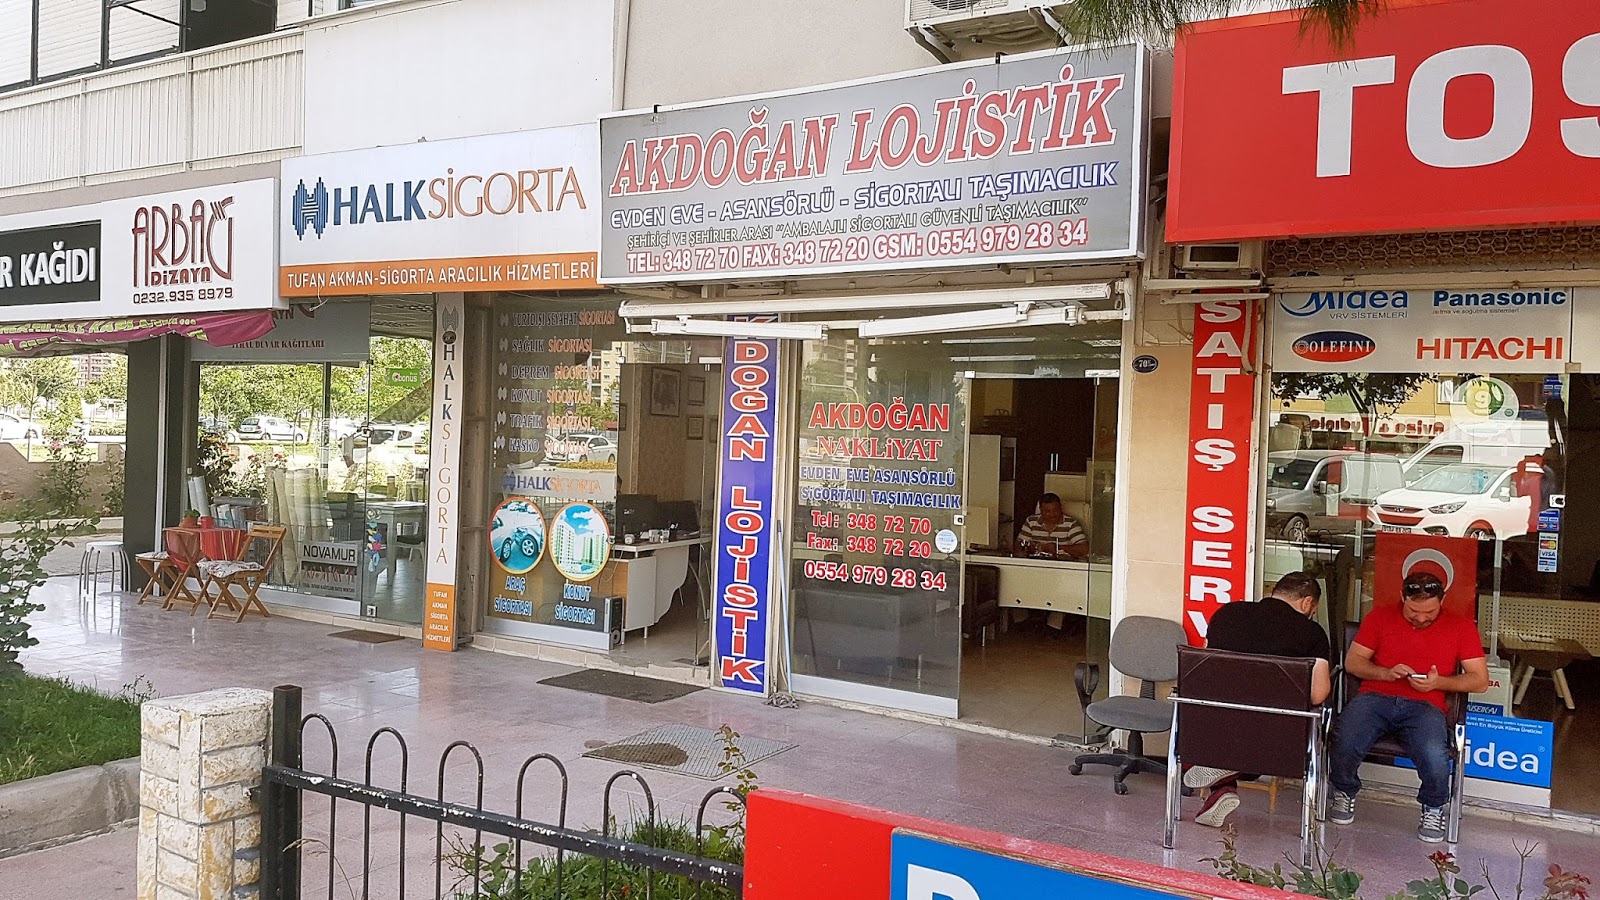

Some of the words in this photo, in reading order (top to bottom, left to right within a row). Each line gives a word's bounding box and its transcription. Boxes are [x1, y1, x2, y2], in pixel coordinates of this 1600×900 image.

[609, 105, 840, 197] AKDOĞAN
[843, 63, 1125, 175] LOJİSTİK
[611, 207, 665, 229] EVDEN
[670, 203, 704, 226] EVE
[720, 186, 834, 221] ASANSÖRLÜ
[854, 177, 962, 209] SİGORTALI
[969, 161, 1119, 201] TAŞIMACILIK
[627, 230, 671, 250] ŞEHİRİÇİ
[672, 231, 686, 246] VE
[689, 227, 737, 247] ŞEHİRLER
[740, 224, 773, 241] ARASI
[849, 211, 916, 233] SİGORTALI
[920, 203, 982, 227] GÜVENLİ
[626, 250, 661, 274] TEL:
[663, 250, 692, 272] 348
[695, 248, 715, 270] 72
[718, 246, 739, 269] 70
[742, 243, 780, 267] FAX:
[783, 241, 816, 266] 348
[819, 238, 843, 262] 72
[845, 235, 870, 261] 20
[873, 232, 923, 259] GSM:
[927, 227, 977, 256] 0554
[980, 222, 1021, 252] 979
[1024, 220, 1054, 249] 28
[1057, 217, 1089, 247] 34
[20, 240, 96, 287] KAĞIDI
[288, 270, 325, 289] TUFAN
[329, 265, 435, 287] AKMAN-SİGORTA
[438, 263, 503, 283] ARACILIK
[506, 256, 595, 281] HİZMETLERİ
[132, 290, 194, 304] 0232.935
[198, 286, 234, 299] 8979
[1433, 287, 1567, 307] Panasonic
[1309, 341, 1371, 353] OLEFINI
[1416, 337, 1563, 361] HITACHI
[511, 365, 549, 380] DEPREM
[510, 388, 543, 404] KONUT
[808, 396, 950, 431] AKDOĞAN
[508, 439, 540, 453] KASKO
[800, 466, 841, 481] EVDEN
[846, 468, 869, 482] EVE
[873, 465, 956, 486] ASANSÖRLÜ
[872, 490, 961, 509] TAŞIMACILIK
[847, 512, 877, 531] 348
[884, 515, 905, 534] 72
[910, 517, 932, 535] 70
[303, 544, 356, 562] NOVAMUR
[846, 536, 877, 553] 348
[883, 538, 904, 556] 72
[909, 540, 932, 559] 20
[804, 560, 848, 582] 0554
[852, 564, 887, 586] 979
[891, 568, 917, 589] 28
[920, 571, 947, 592] 34
[563, 582, 592, 602] KONUT
